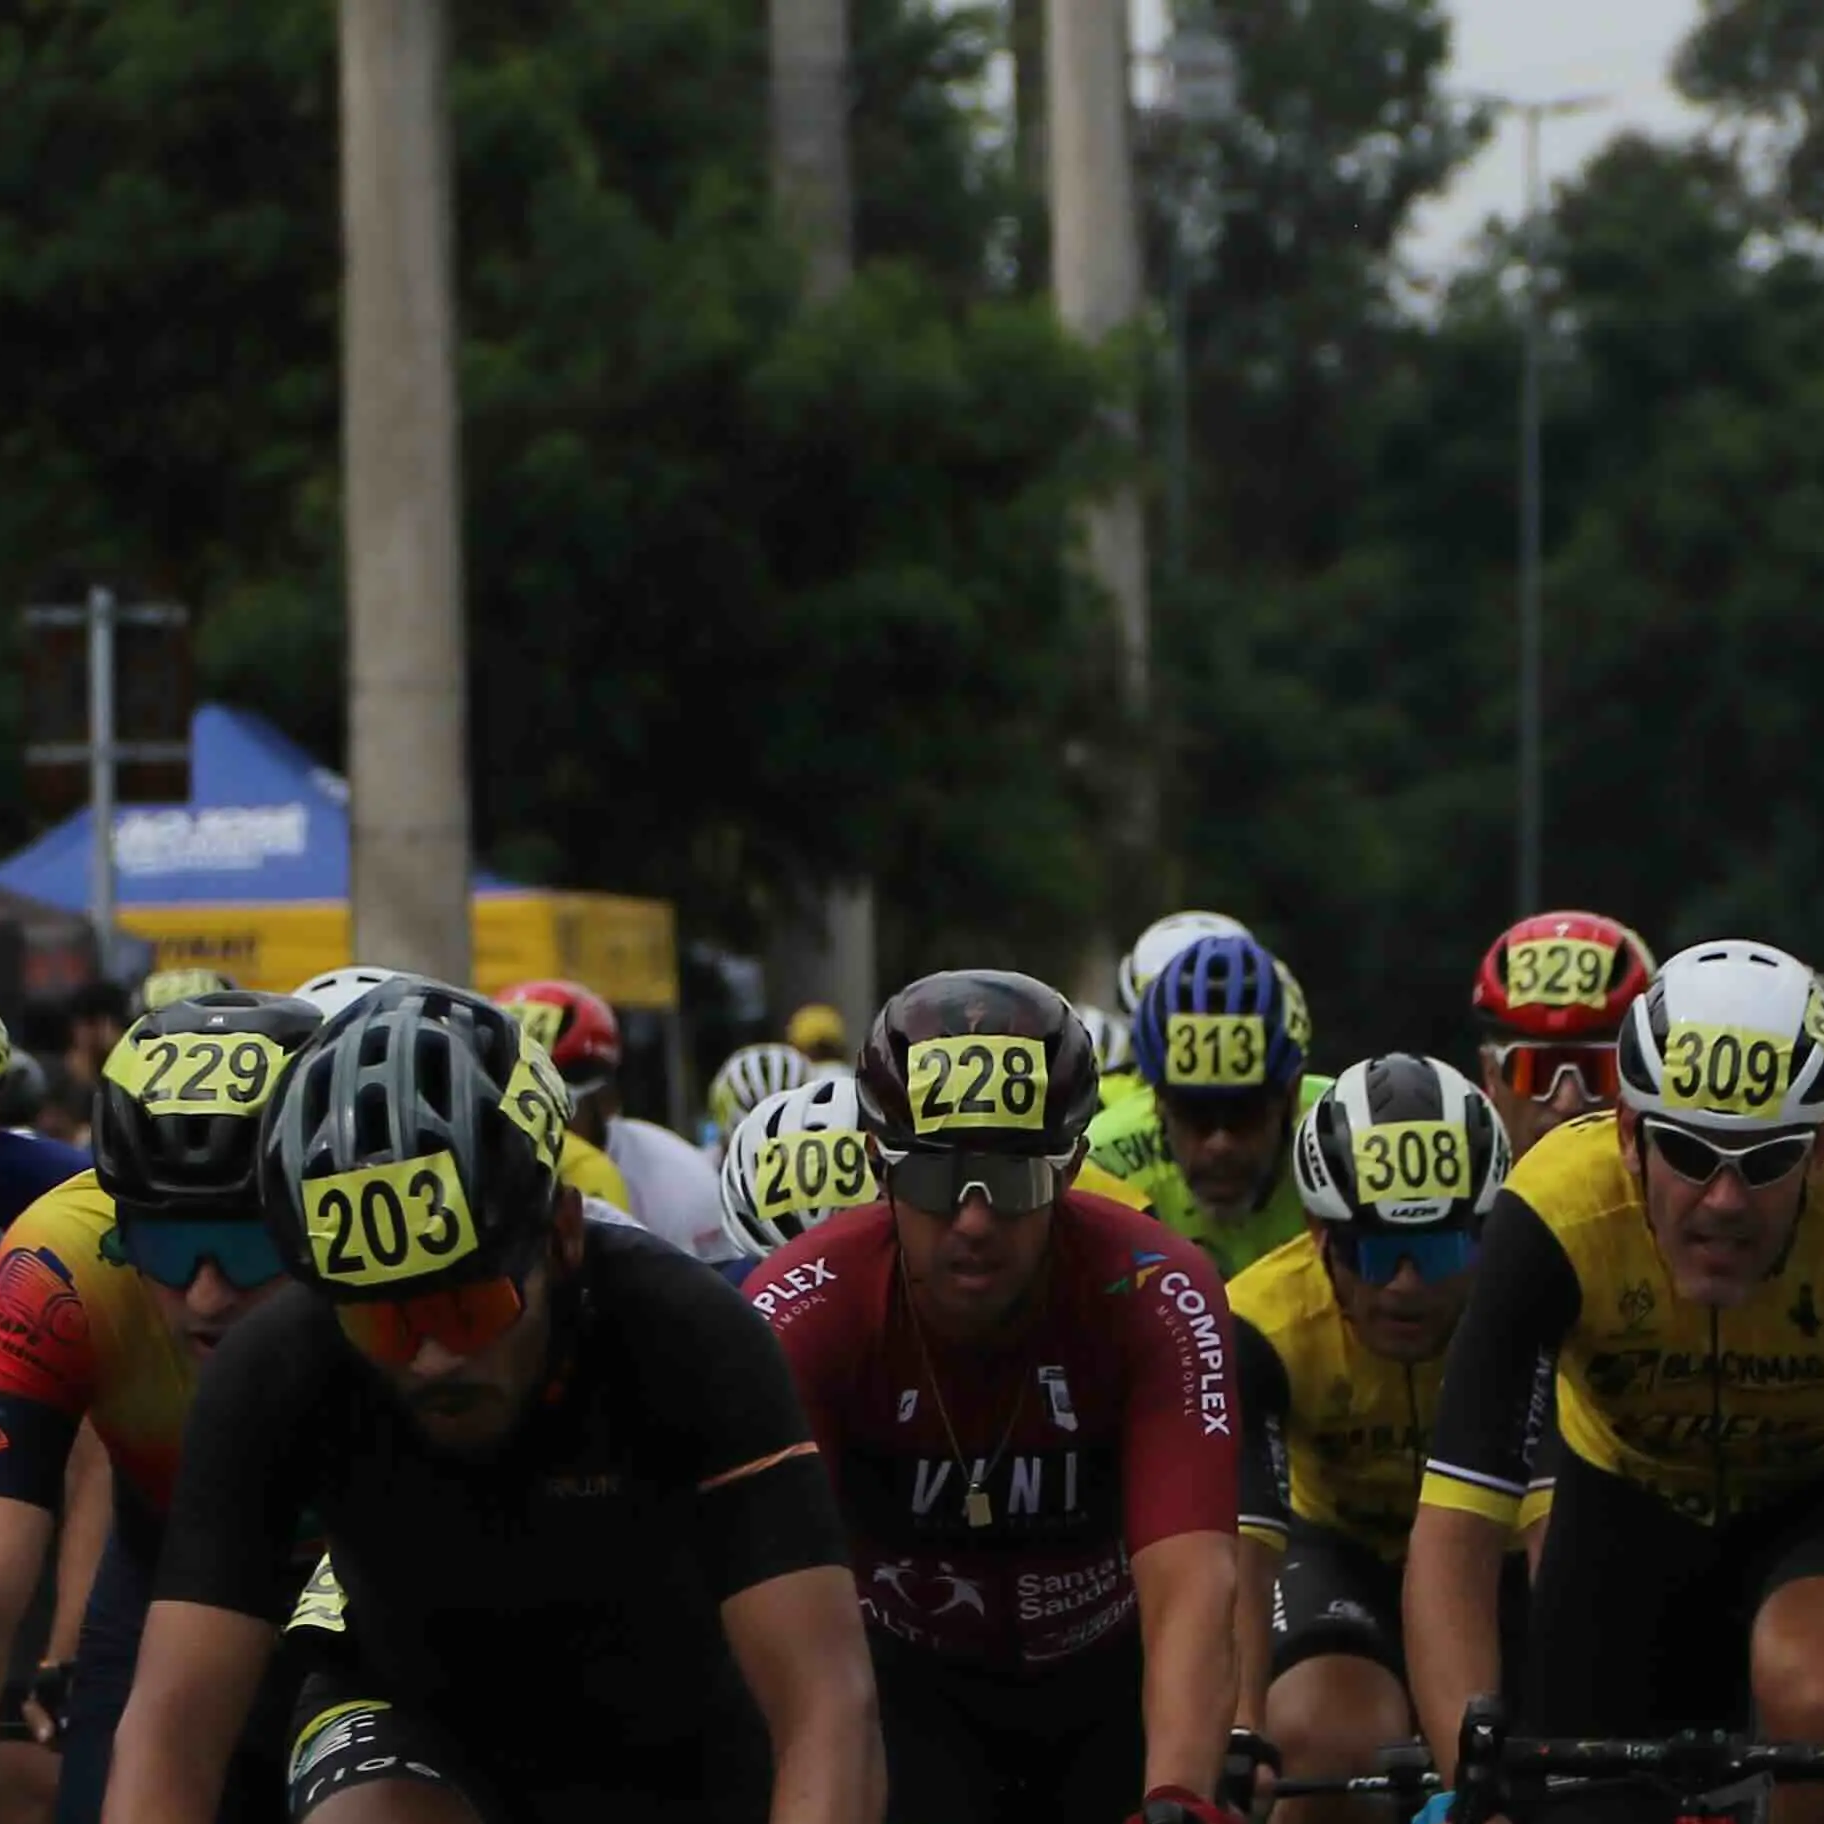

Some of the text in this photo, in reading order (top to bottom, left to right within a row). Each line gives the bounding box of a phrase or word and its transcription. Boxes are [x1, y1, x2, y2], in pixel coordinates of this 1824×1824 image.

[1515, 946, 1602, 995] 329
[141, 1041, 270, 1103] 229
[917, 1045, 1037, 1117] 228
[1174, 1023, 1256, 1077] 313
[1672, 1032, 1780, 1107] 309
[764, 1137, 868, 1204] 209
[1364, 1130, 1461, 1191] 308
[317, 1169, 460, 1275] 203
[1159, 1271, 1232, 1437] COMPLEX
[910, 1449, 1078, 1517] VINI
[1016, 1558, 1116, 1597] Santa
